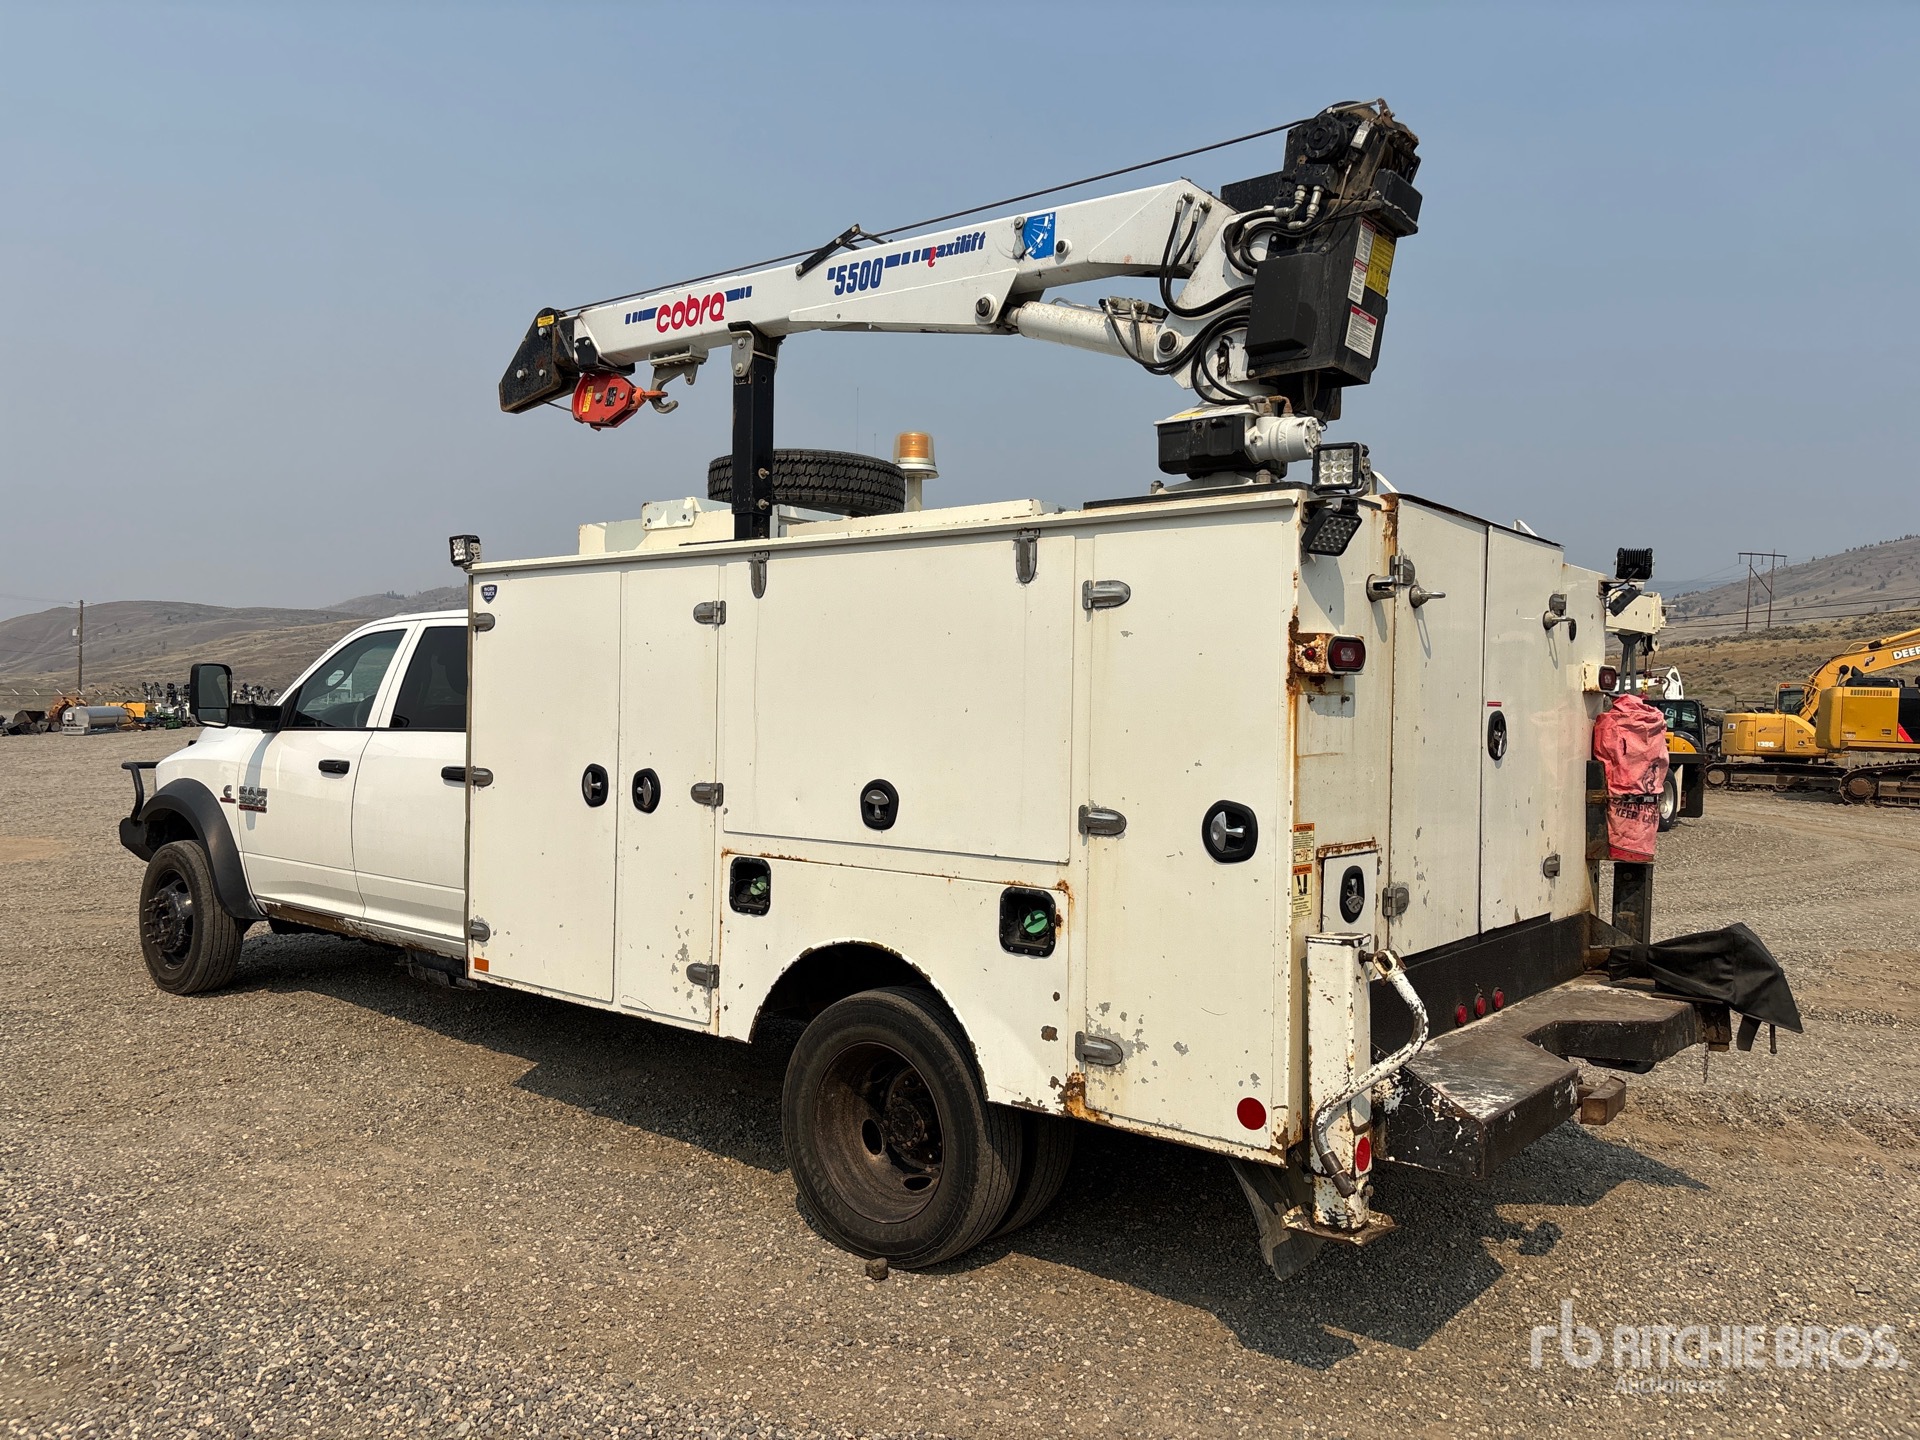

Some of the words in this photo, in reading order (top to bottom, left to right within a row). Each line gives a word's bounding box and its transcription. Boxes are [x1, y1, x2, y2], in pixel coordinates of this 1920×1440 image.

[834, 257, 883, 296] 5500
[656, 291, 725, 333] cobra
[239, 786, 267, 797] RAM
